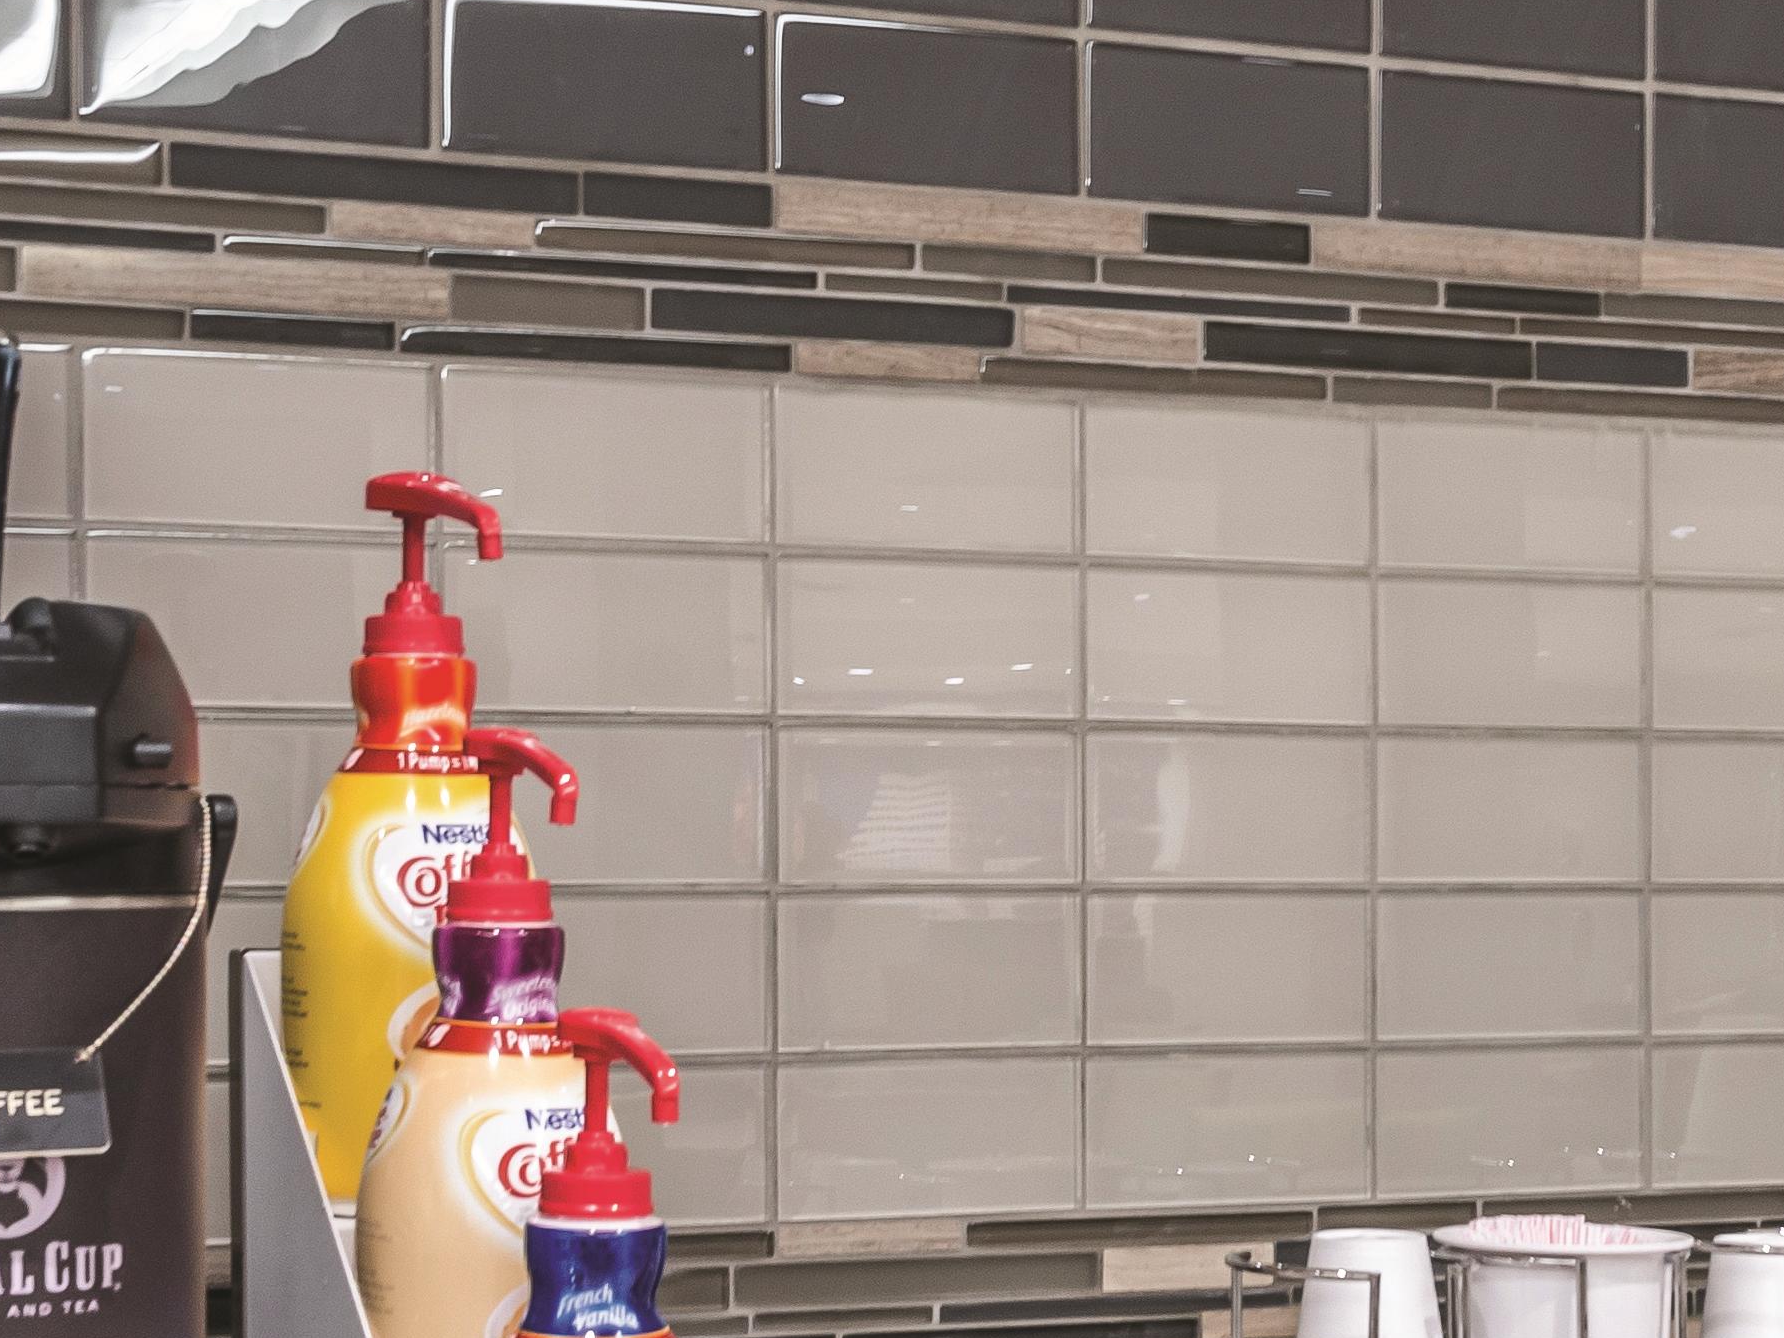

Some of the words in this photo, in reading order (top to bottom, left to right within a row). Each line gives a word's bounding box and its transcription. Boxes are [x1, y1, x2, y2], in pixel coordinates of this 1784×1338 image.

[525, 1107, 586, 1130] Nest
[7, 1301, 53, 1318] AND
[62, 1299, 100, 1314] TEA
[557, 1283, 613, 1319] French
